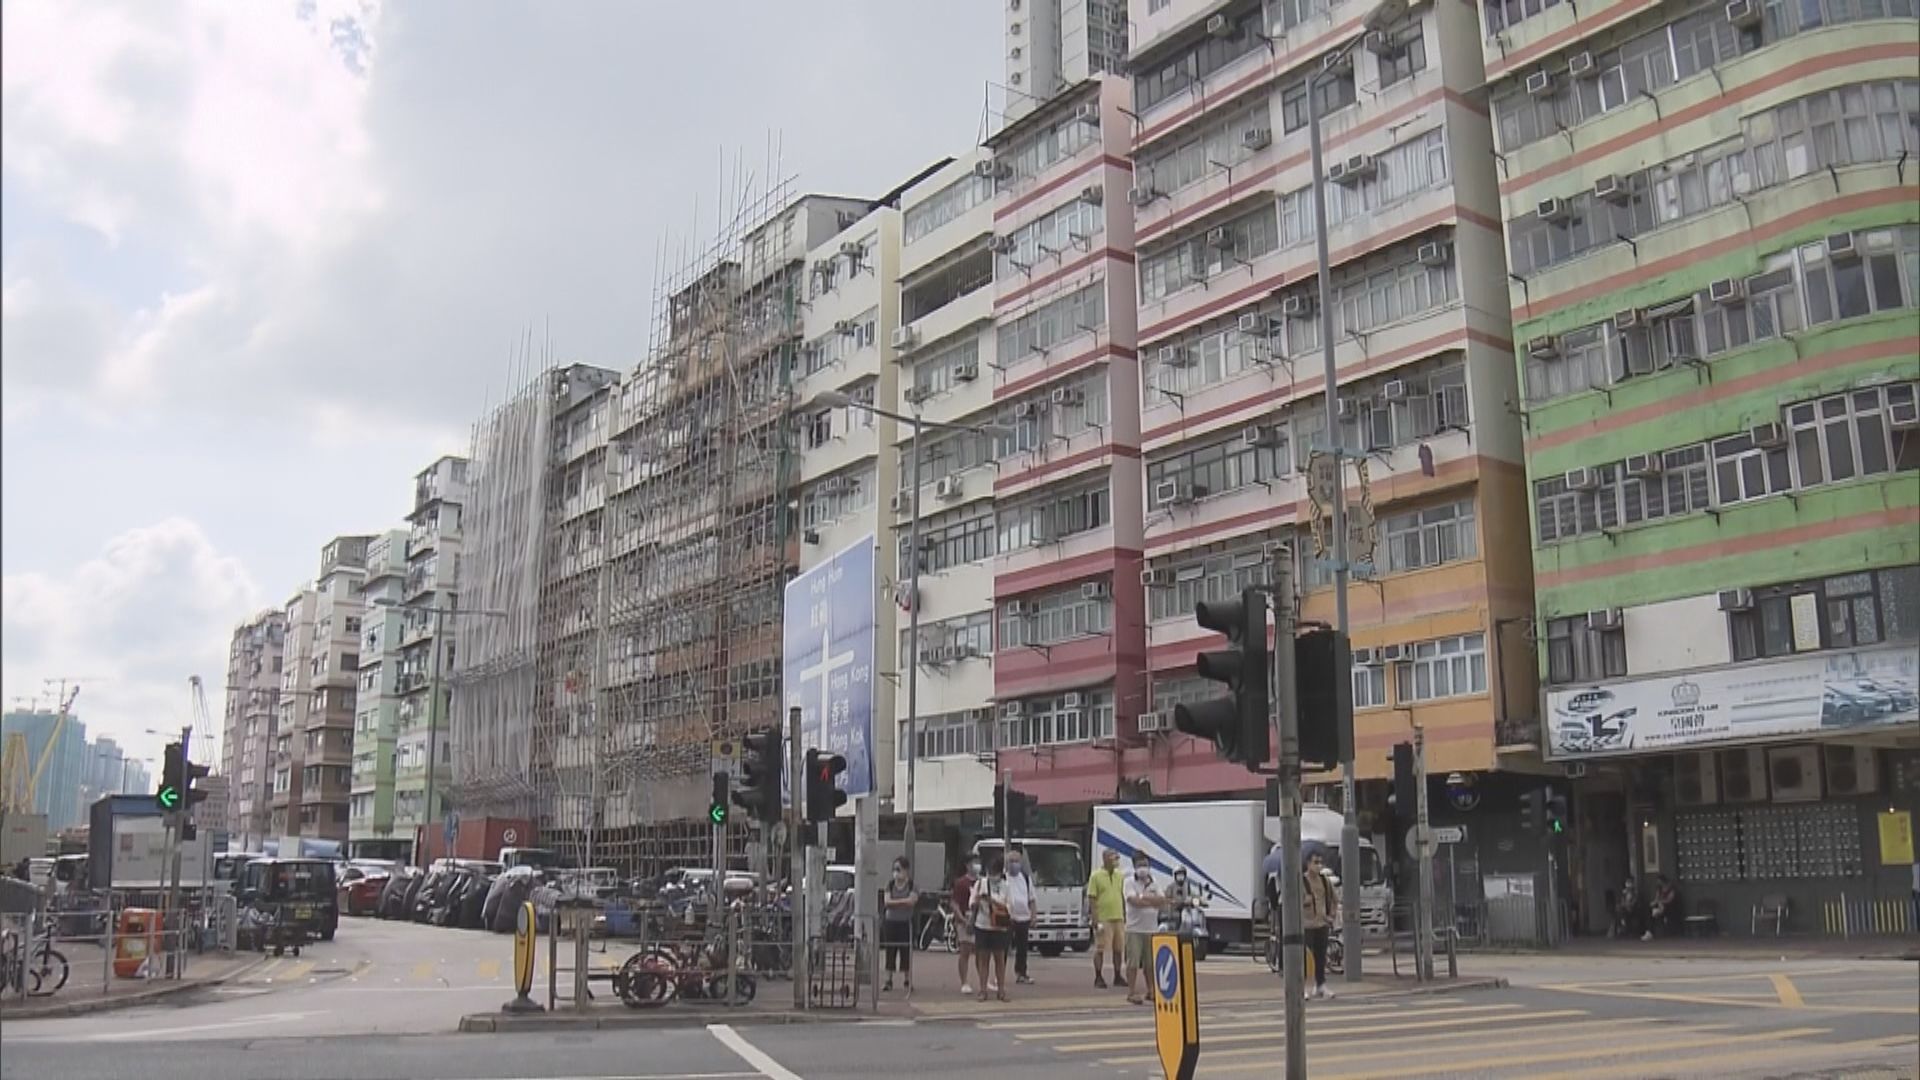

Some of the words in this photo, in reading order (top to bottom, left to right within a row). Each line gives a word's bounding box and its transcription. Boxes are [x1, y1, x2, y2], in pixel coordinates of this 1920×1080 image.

[830, 672, 848, 691] Hong
[851, 664, 869, 684] Kong
[832, 698, 849, 728] 香港
[830, 732, 848, 753] Mong
[851, 726, 864, 747] Kok
